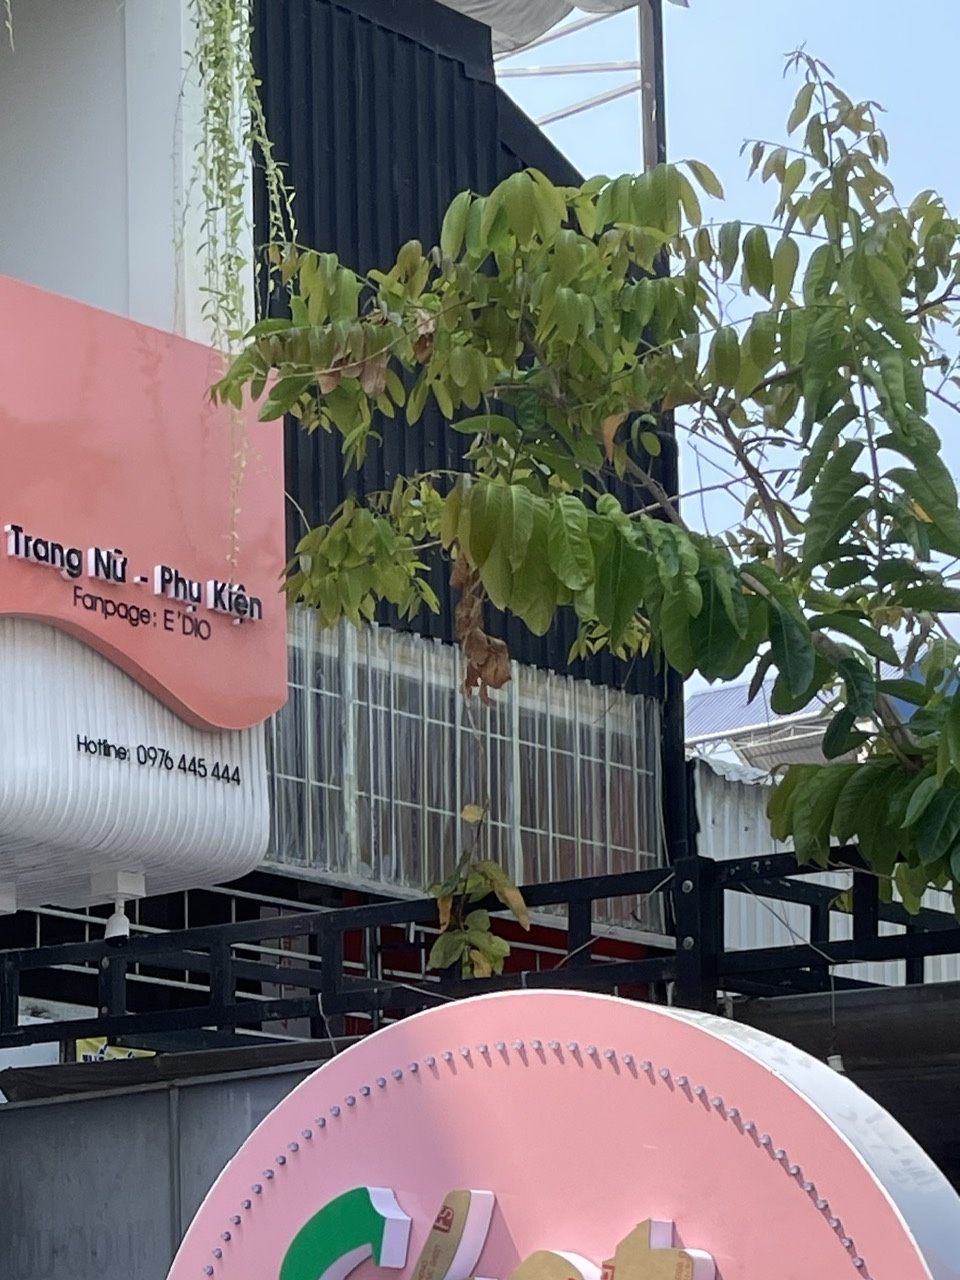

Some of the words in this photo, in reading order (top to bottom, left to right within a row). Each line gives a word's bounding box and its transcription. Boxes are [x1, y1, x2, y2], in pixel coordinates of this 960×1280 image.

[4, 523, 83, 581] Trang
[87, 546, 129, 584] Nữ
[154, 563, 203, 614] Phụ
[206, 579, 263, 626] Kiện
[73, 585, 158, 630] Fanpage:
[163, 609, 212, 641] E'DIO
[76, 733, 131, 762] Hotline:
[136, 744, 174, 771] 0976
[177, 754, 208, 778] 445
[211, 762, 241, 786] 444
